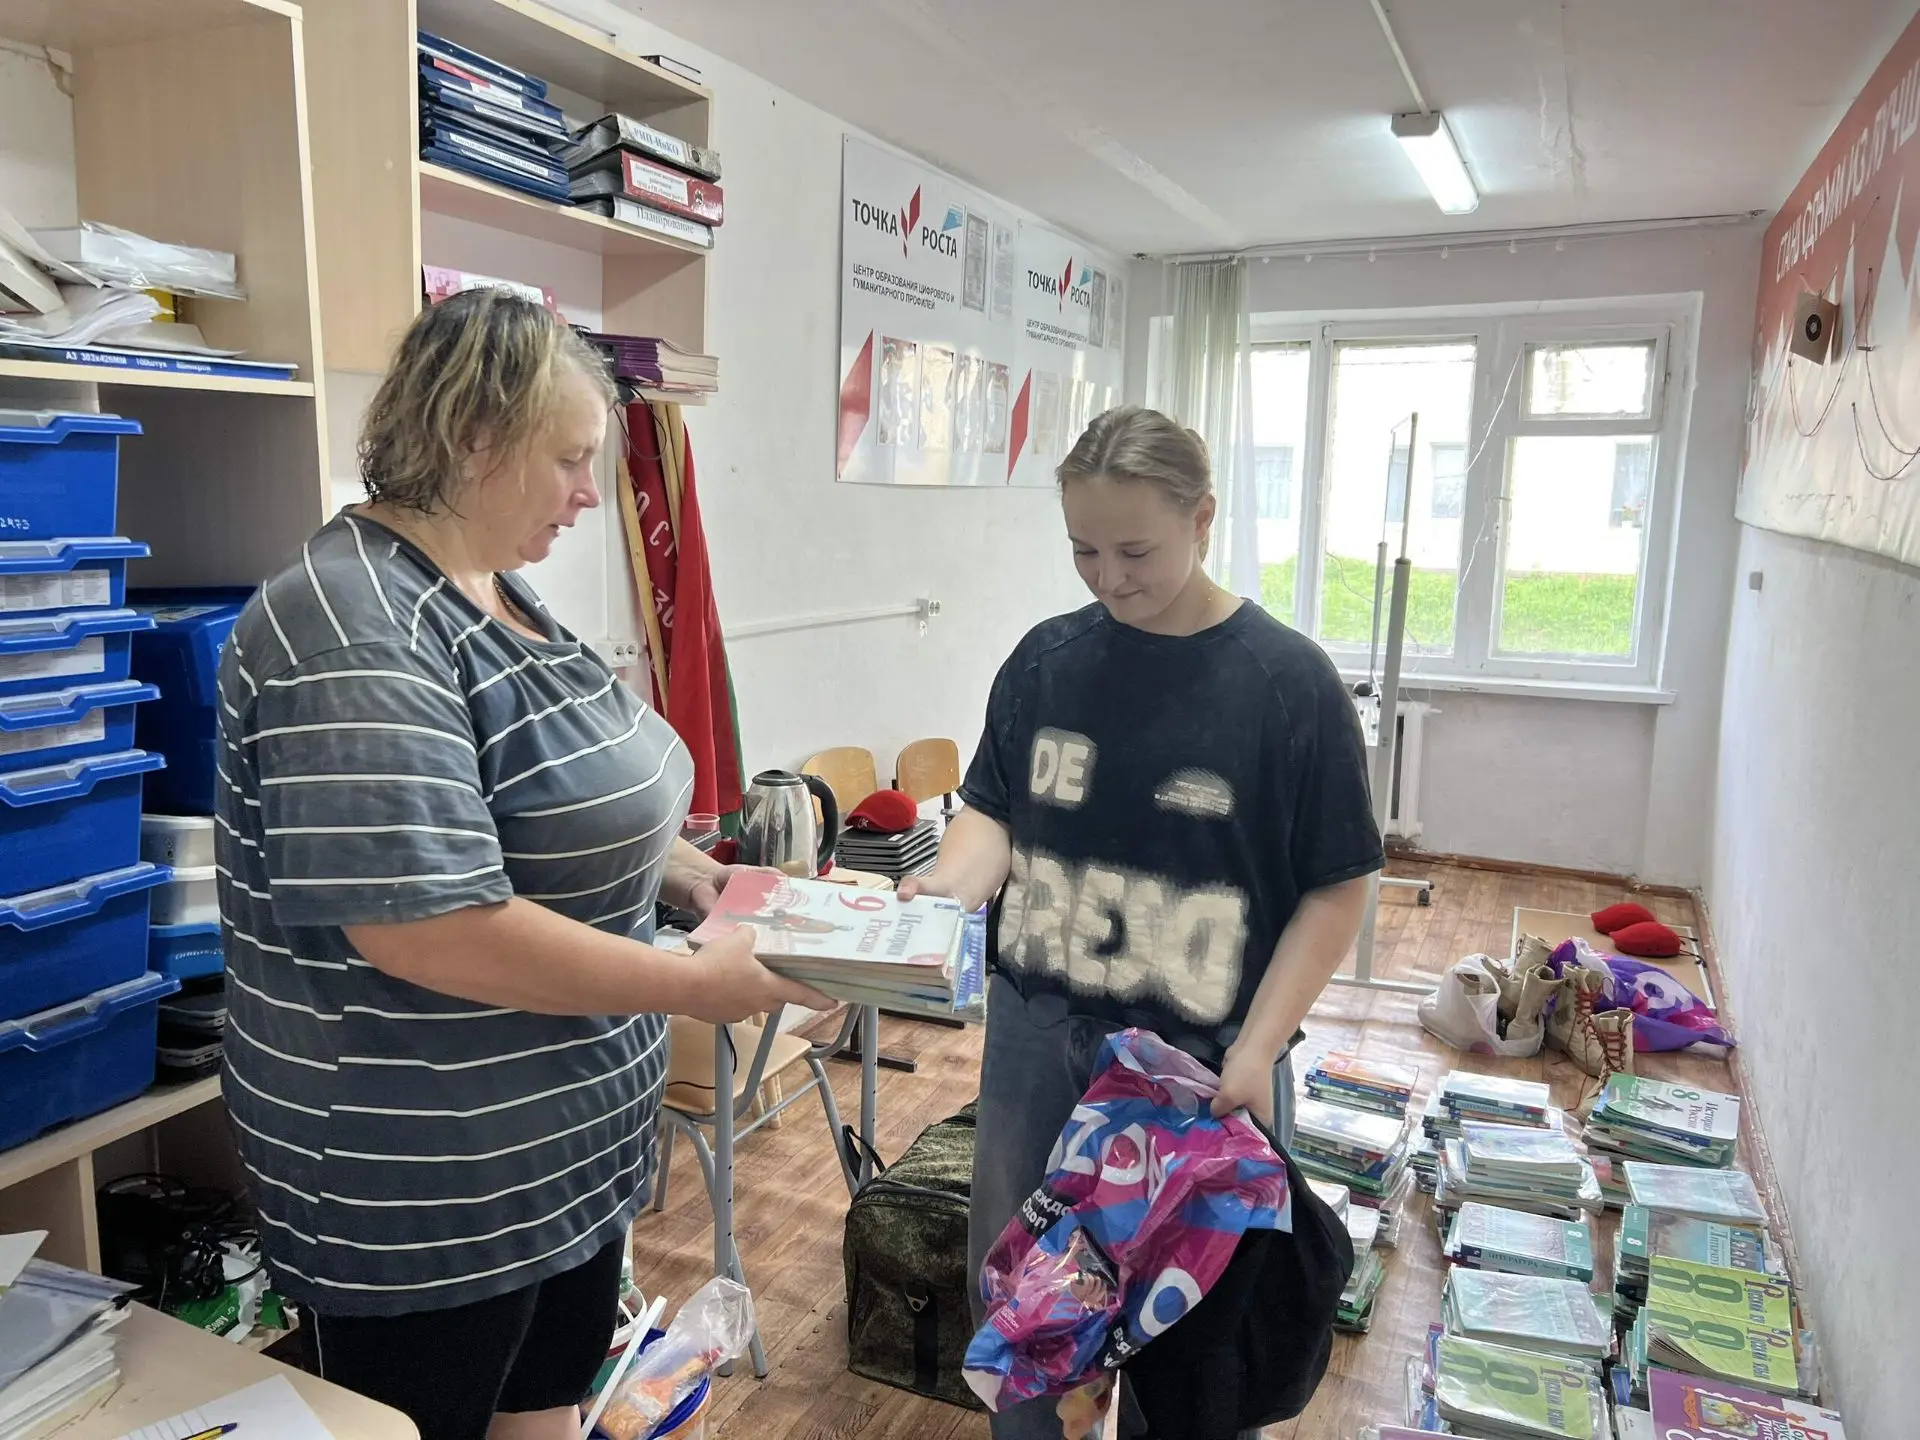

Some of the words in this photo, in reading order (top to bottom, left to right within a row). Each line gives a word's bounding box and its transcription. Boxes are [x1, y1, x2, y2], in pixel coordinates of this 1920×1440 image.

[637, 206, 695, 234] Планирование
[852, 199, 898, 237] ТОЧКА
[922, 226, 957, 259] РОСТА
[852, 277, 905, 301] ГУМАНИТАРНОГО
[906, 293, 936, 311] ПРОФИЛЕЙ
[853, 263, 874, 276] ЦЕНТР
[875, 270, 918, 290] ОБРАЗОВАНИЯ
[918, 283, 951, 302] ЦИФРОВОГО
[1028, 269, 1057, 296] ТОЧКА
[1070, 285, 1090, 309] РОСТА
[1031, 738, 1089, 802] DE
[838, 892, 887, 911] 9
[856, 919, 892, 953] России
[885, 913, 923, 956] История
[1671, 1089, 1700, 1101] 8
[1687, 1105, 1703, 1129] России
[1700, 1102, 1719, 1132] История
[1022, 1197, 1048, 1229] Ozon
[1626, 1237, 1643, 1247] 8
[1650, 1264, 1743, 1303] 8
[1648, 1308, 1745, 1350] 8
[1440, 1355, 1540, 1395] 8
